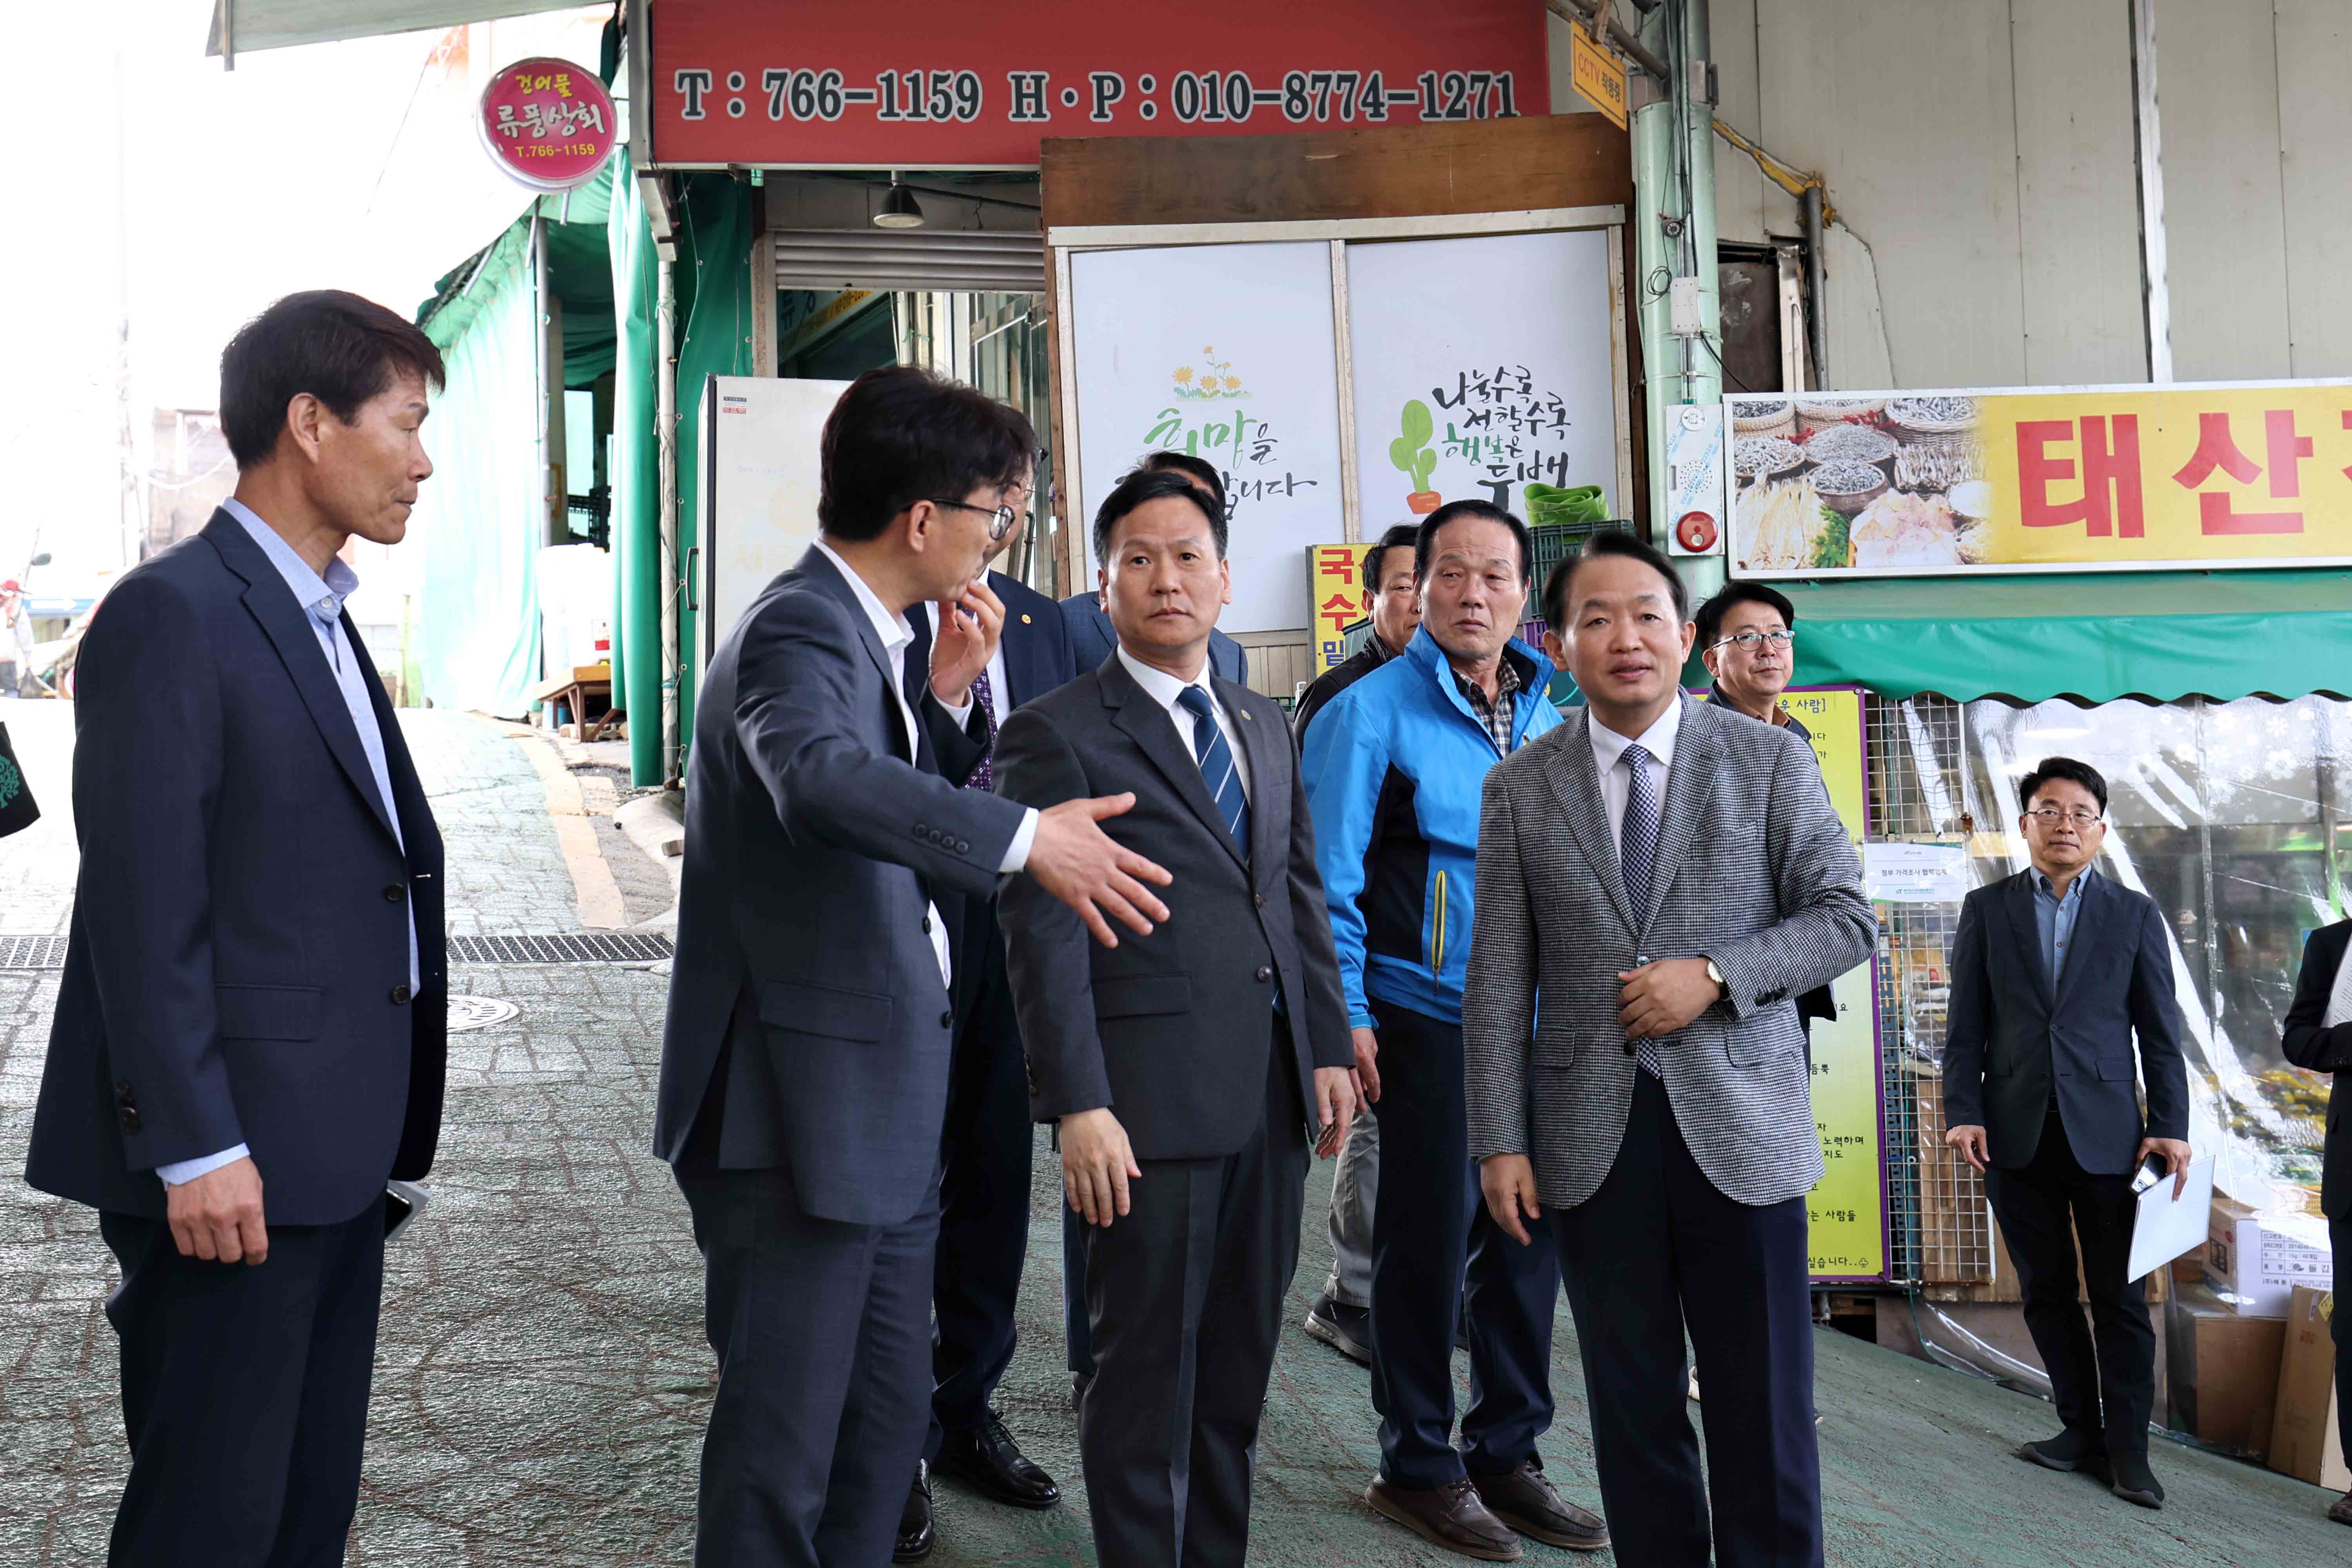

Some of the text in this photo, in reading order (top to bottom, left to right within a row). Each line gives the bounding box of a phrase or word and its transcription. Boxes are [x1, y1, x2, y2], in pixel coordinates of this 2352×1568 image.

[515, 73, 572, 98] 건어물
[1579, 51, 1621, 103] CCTV 작동중
[497, 100, 606, 138] 류풍상회
[515, 143, 595, 157] T.766-1159
[1432, 365, 1532, 410] 나눌수록
[1463, 392, 1571, 440] 전할수록
[1441, 423, 1524, 466] 행복은
[2016, 409, 2352, 538] 태산
[1797, 698, 1825, 713] 사람]
[1823, 1136, 1864, 1147] 노력하며
[1824, 1150, 1843, 1158] 지도
[1825, 1210, 1856, 1222] 사람들
